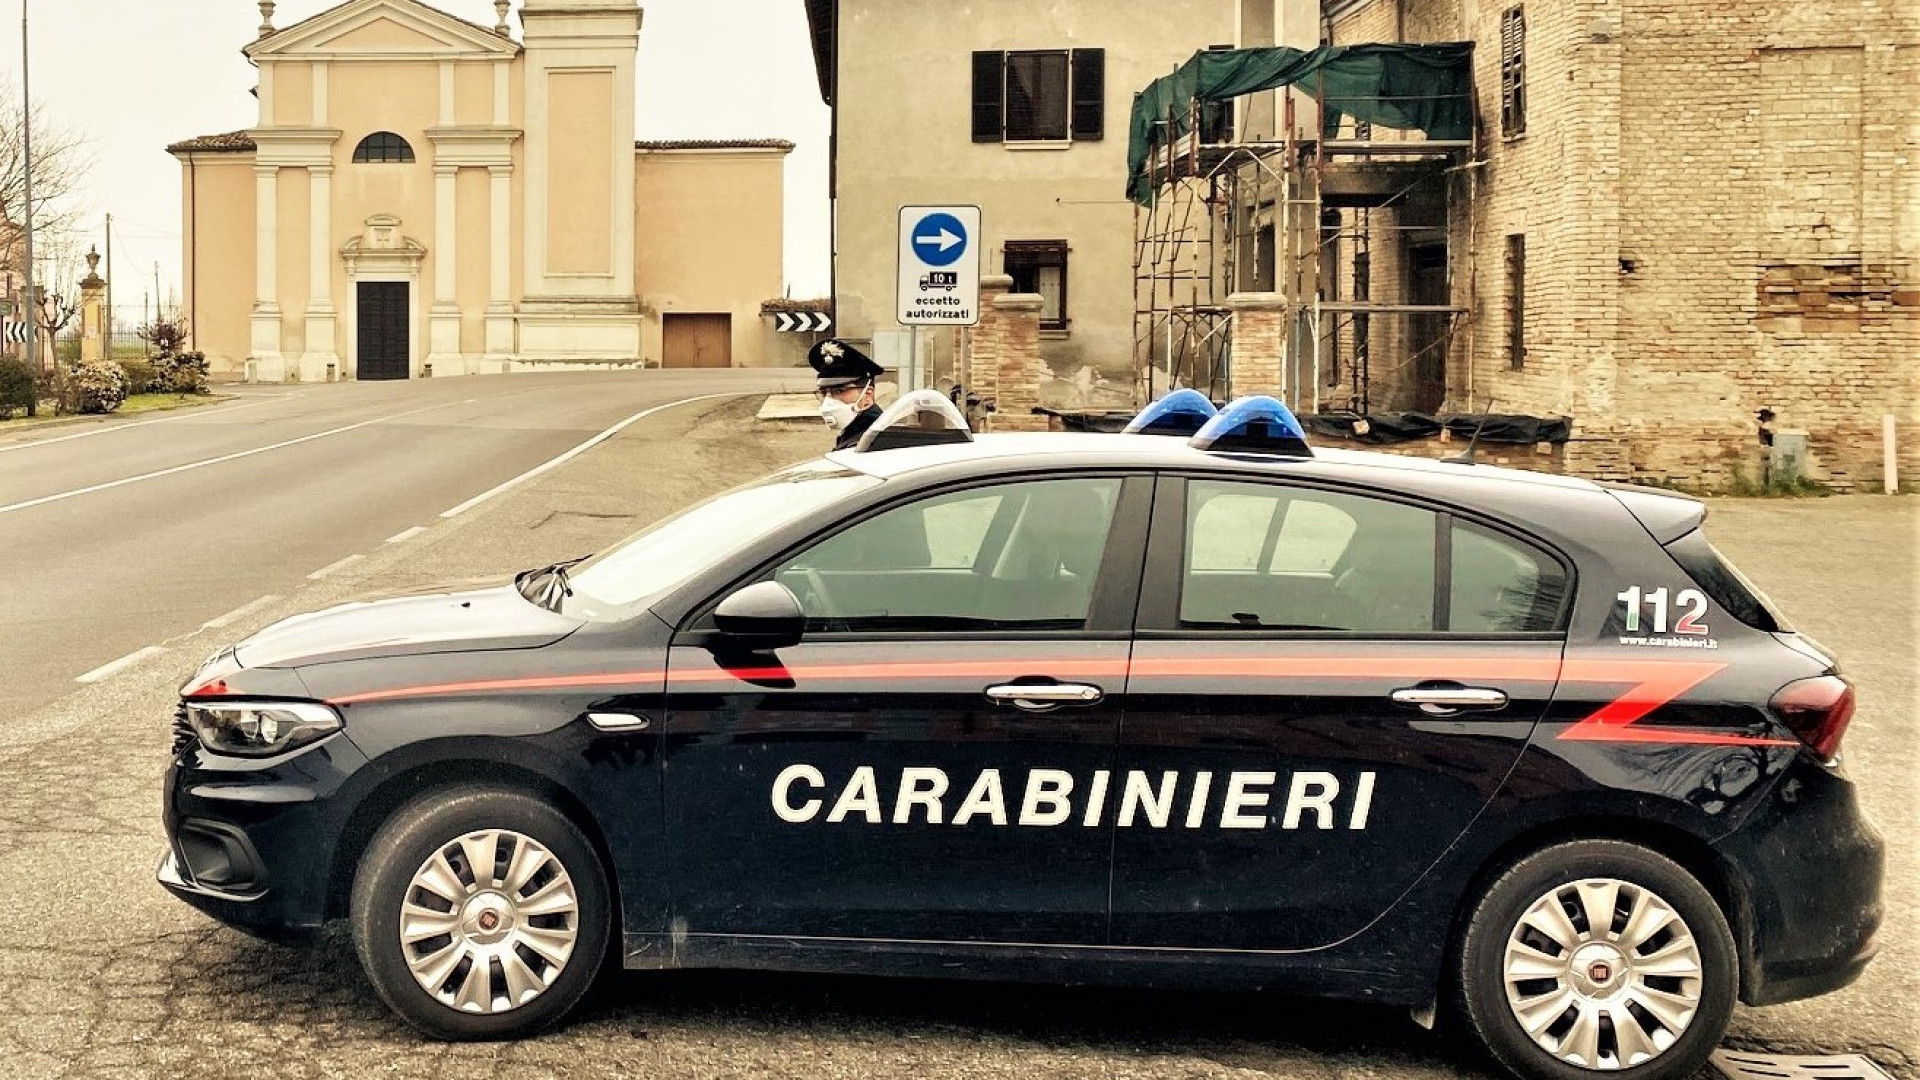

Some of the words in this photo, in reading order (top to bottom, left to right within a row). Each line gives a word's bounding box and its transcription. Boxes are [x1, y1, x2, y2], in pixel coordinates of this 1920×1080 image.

[934, 273, 945, 283] 10
[915, 296, 960, 305] eccetto
[906, 309, 969, 319] autorizzati
[1617, 585, 1709, 635] 112
[1620, 636, 1718, 649] www.carabinieri.it
[771, 764, 1376, 830] CARABINIERI
